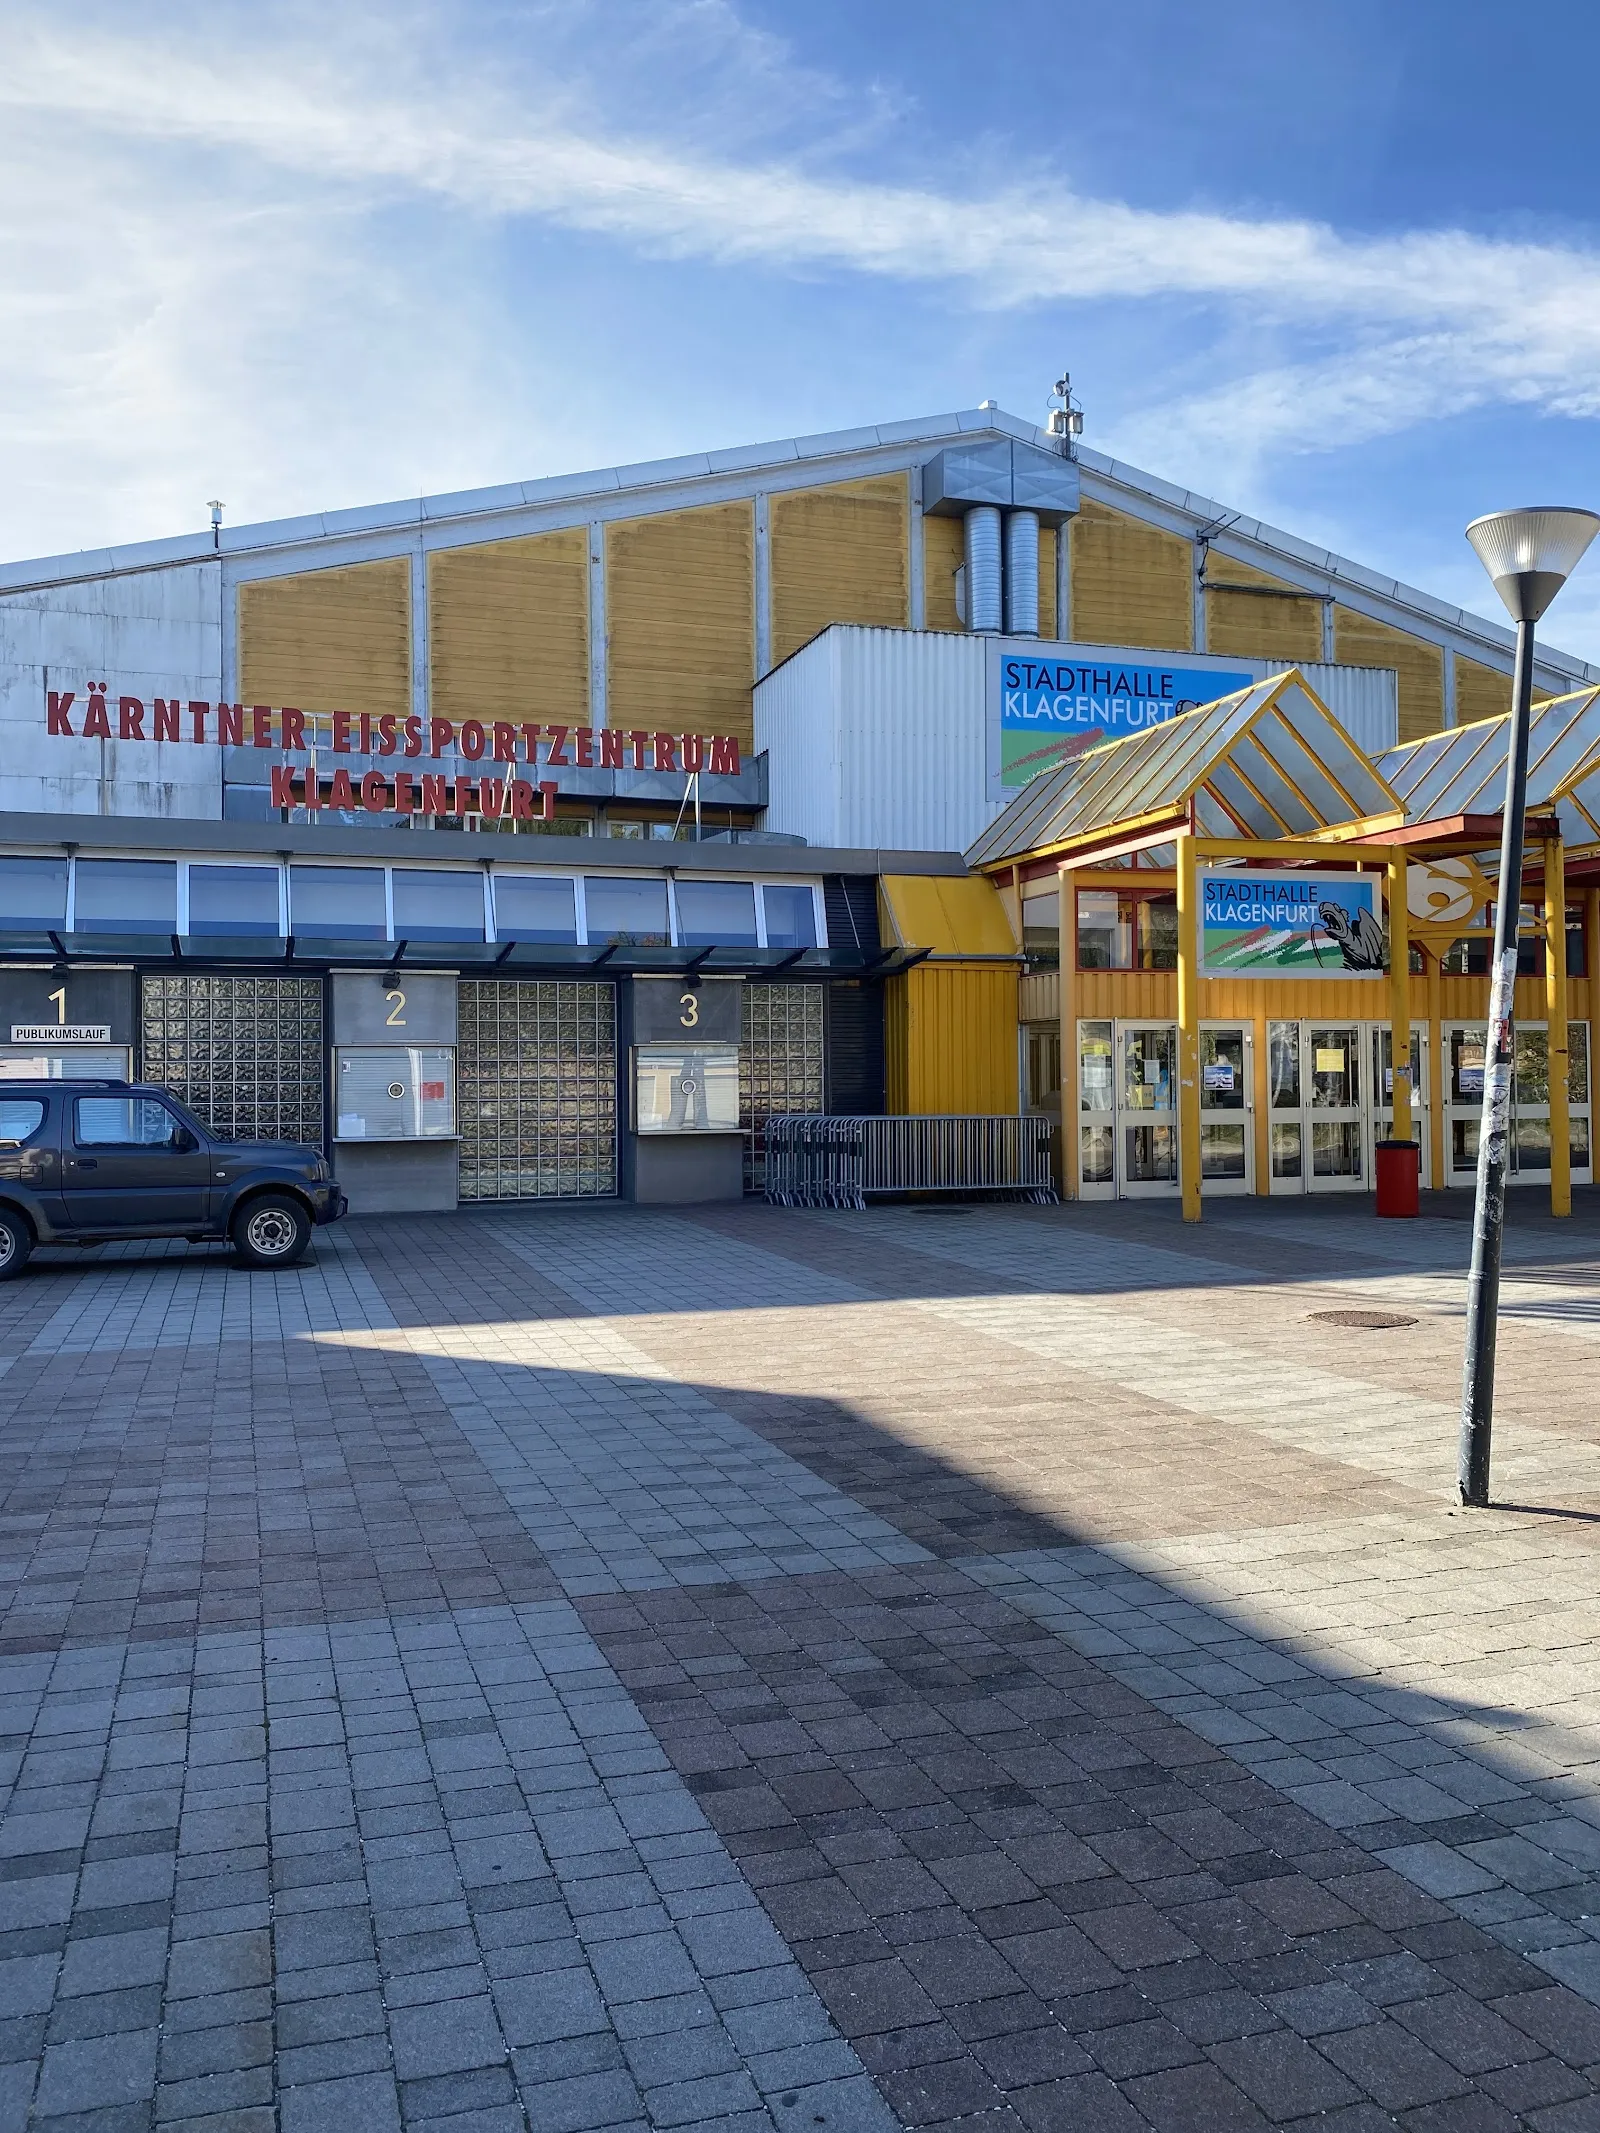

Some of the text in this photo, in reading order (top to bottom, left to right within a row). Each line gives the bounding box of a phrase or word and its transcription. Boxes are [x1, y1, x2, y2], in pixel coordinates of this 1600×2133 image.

[1005, 662, 1174, 699] STADTHALLE
[1005, 691, 1174, 726] KLAGENFURT
[47, 681, 741, 776] KÄRNTNER EISSPORTZENTRUM
[271, 765, 559, 821] KLAGENFURT
[1205, 882, 1318, 903] STADTHALLE
[1205, 903, 1318, 924] KLAGENFURT
[47, 986, 66, 1025] 1
[385, 990, 407, 1026] 2
[679, 993, 699, 1028] 3
[15, 1028, 106, 1041] PUBLIKUMSLAUF
